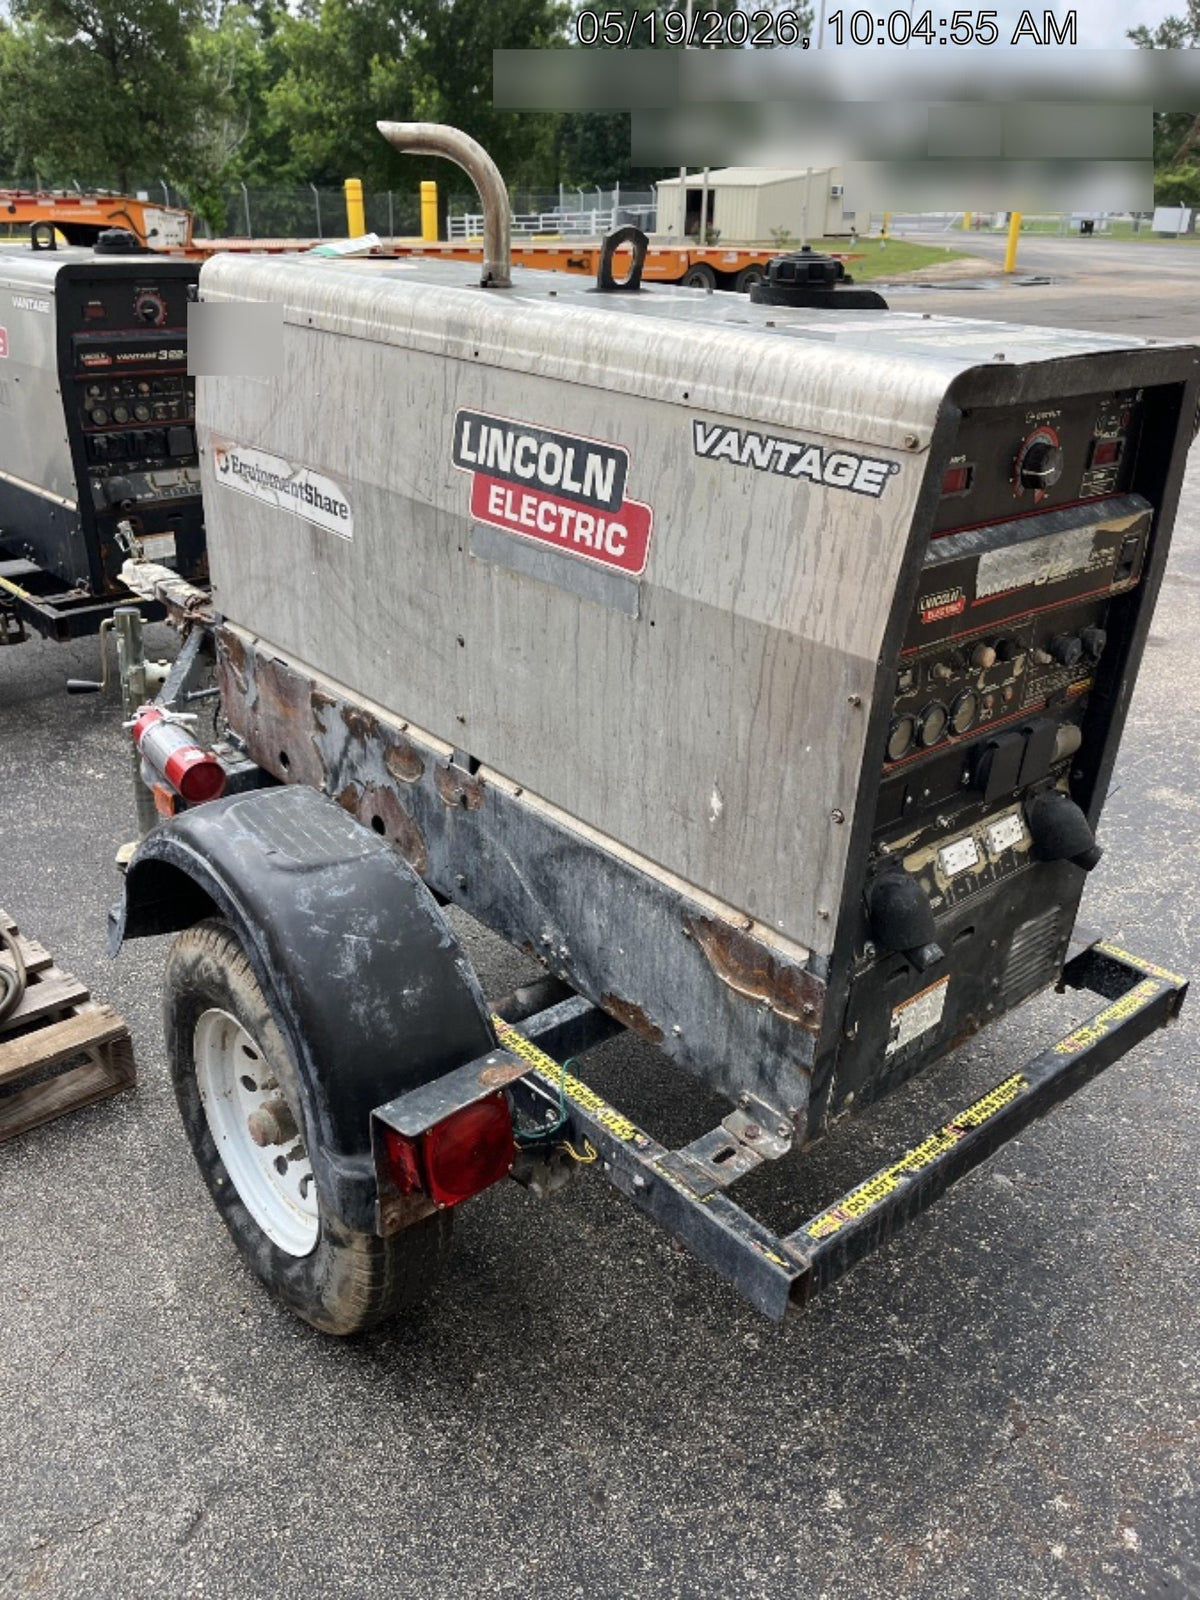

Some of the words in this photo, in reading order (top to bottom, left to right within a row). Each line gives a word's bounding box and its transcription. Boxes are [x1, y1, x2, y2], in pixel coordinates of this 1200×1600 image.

[460, 420, 617, 503] LINCOLN
[488, 485, 628, 557] ELECTRIC
[847, 1195, 867, 1213] DO
[864, 1177, 891, 1200] NOT
